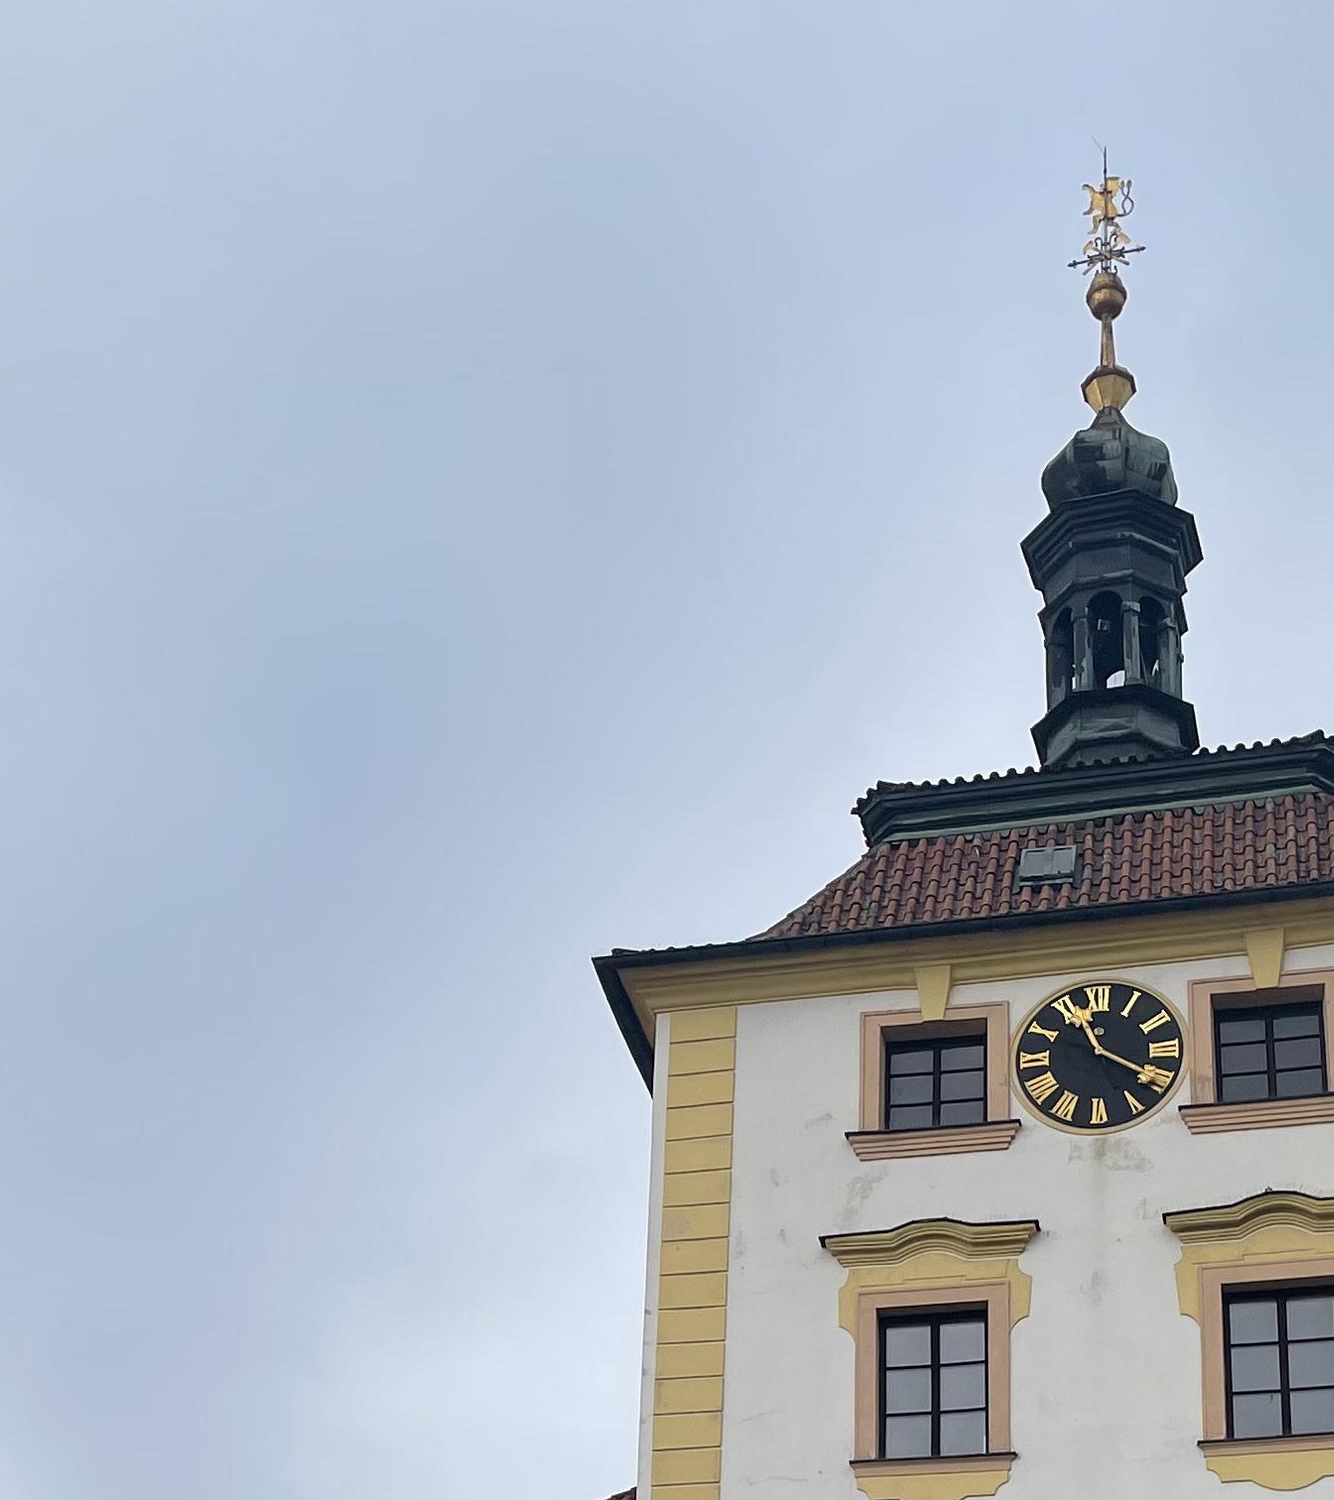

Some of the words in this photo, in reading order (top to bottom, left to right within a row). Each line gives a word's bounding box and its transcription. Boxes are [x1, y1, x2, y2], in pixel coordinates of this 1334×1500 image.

[1051, 994, 1079, 1025] XI
[1083, 985, 1112, 1012] XII
[1028, 1020, 1060, 1043] X
[1138, 1009, 1171, 1035] II
[1020, 1049, 1050, 1070] IX
[1149, 1037, 1179, 1059] III
[1024, 1070, 1060, 1106] VIII
[1048, 1089, 1079, 1122] VII
[1090, 1097, 1109, 1125] VI
[1124, 1090, 1145, 1115] V
